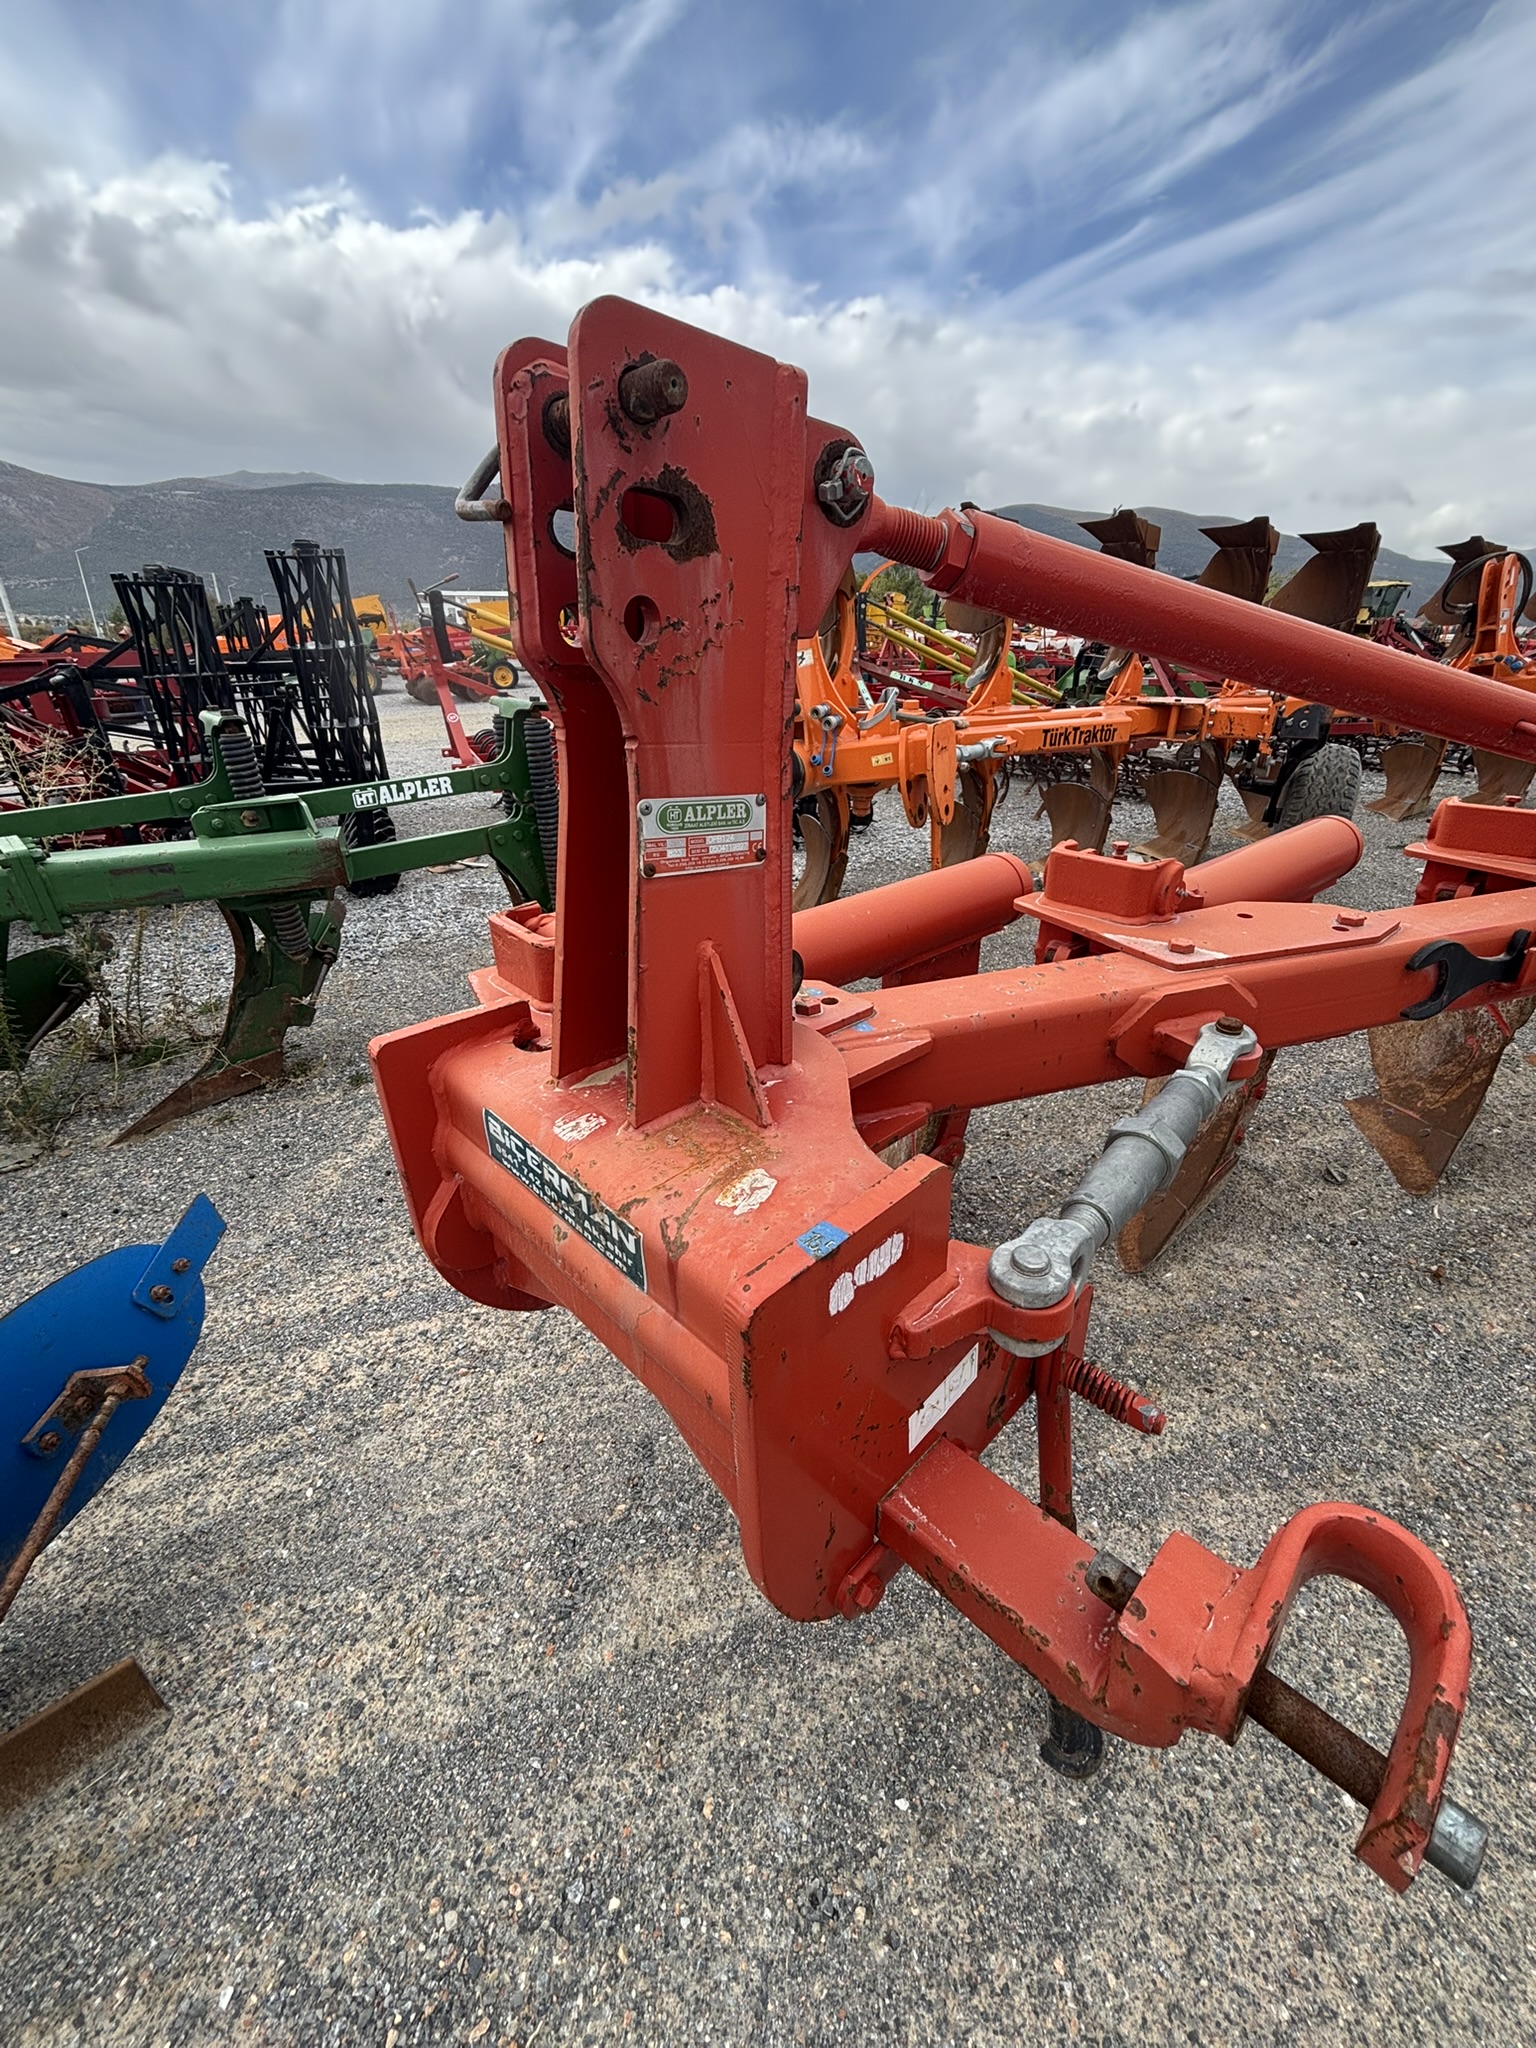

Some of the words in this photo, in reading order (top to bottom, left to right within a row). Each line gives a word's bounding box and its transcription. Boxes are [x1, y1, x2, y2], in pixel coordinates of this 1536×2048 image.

[1042, 724, 1117, 747] TürkTraktör
[380, 777, 453, 804] ALPLER
[684, 803, 747, 822] ALPLER
